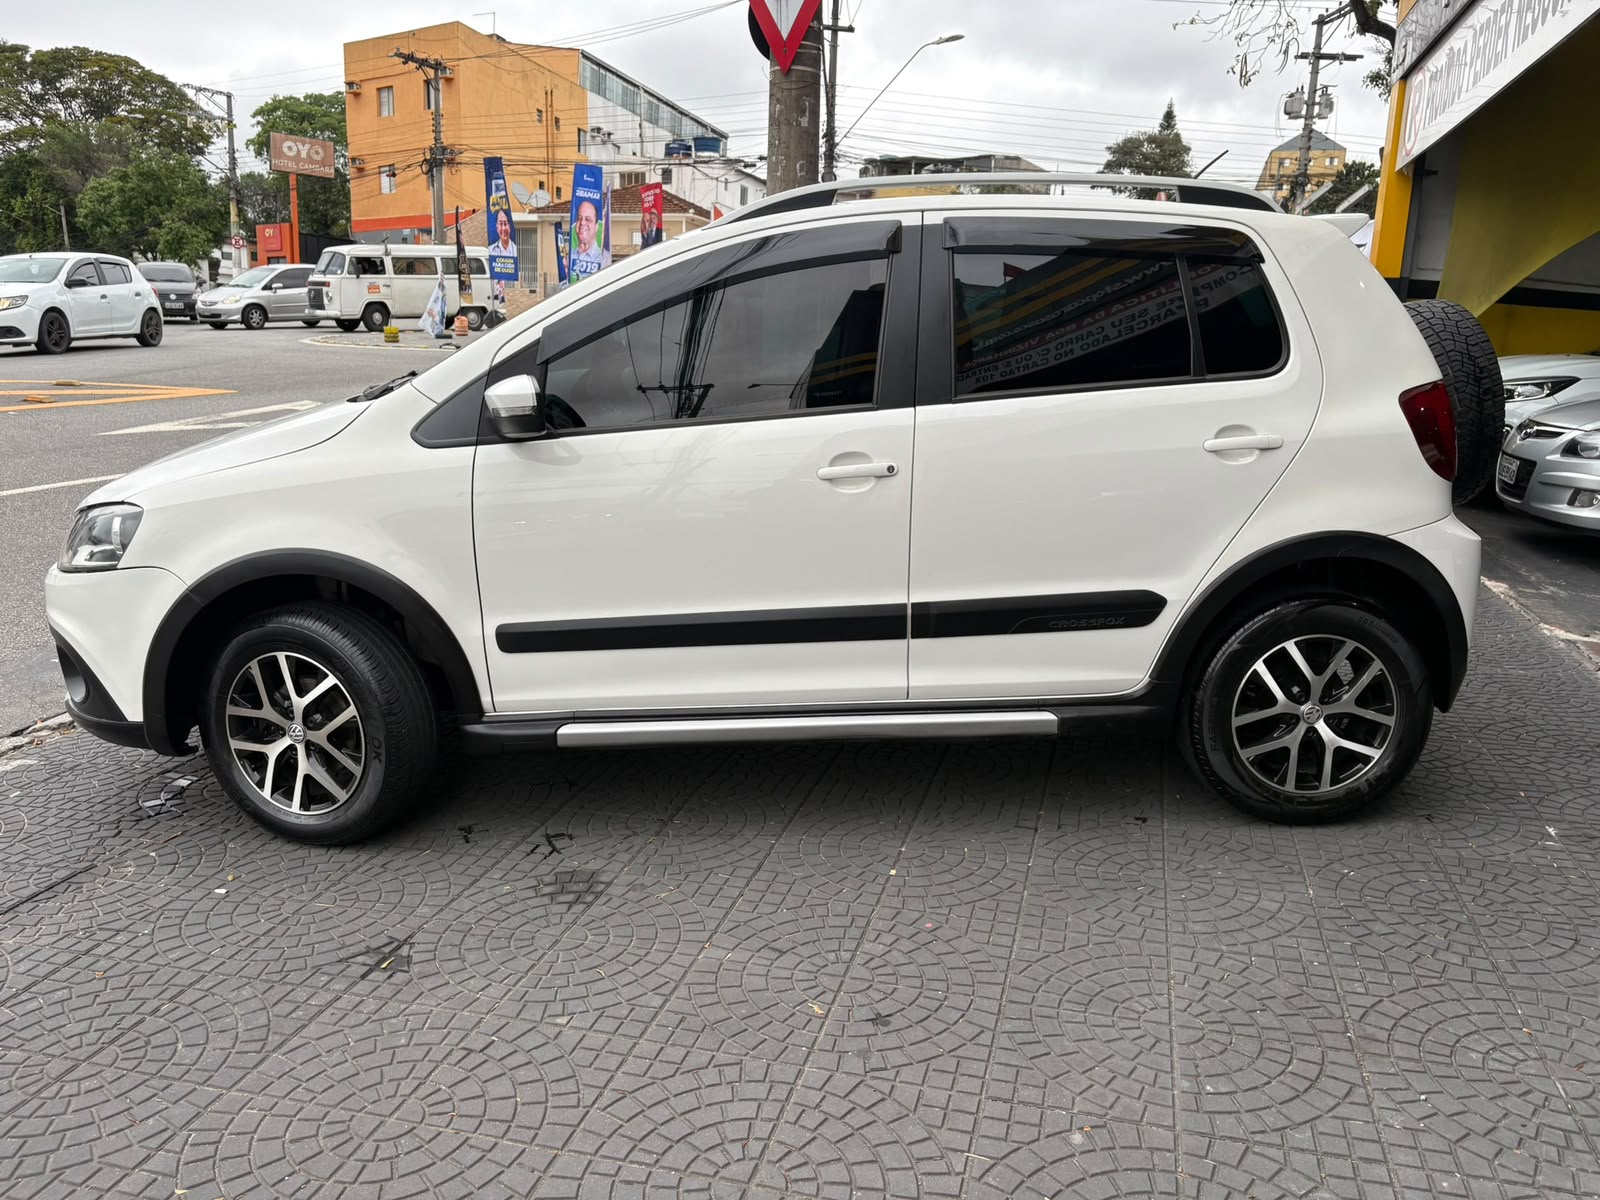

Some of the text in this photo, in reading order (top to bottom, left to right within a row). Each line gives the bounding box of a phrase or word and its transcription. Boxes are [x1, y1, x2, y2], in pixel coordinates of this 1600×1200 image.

[282, 140, 325, 161] OYO
[272, 158, 297, 169] HOTEL
[1048, 615, 1125, 629] CROSSFOX
